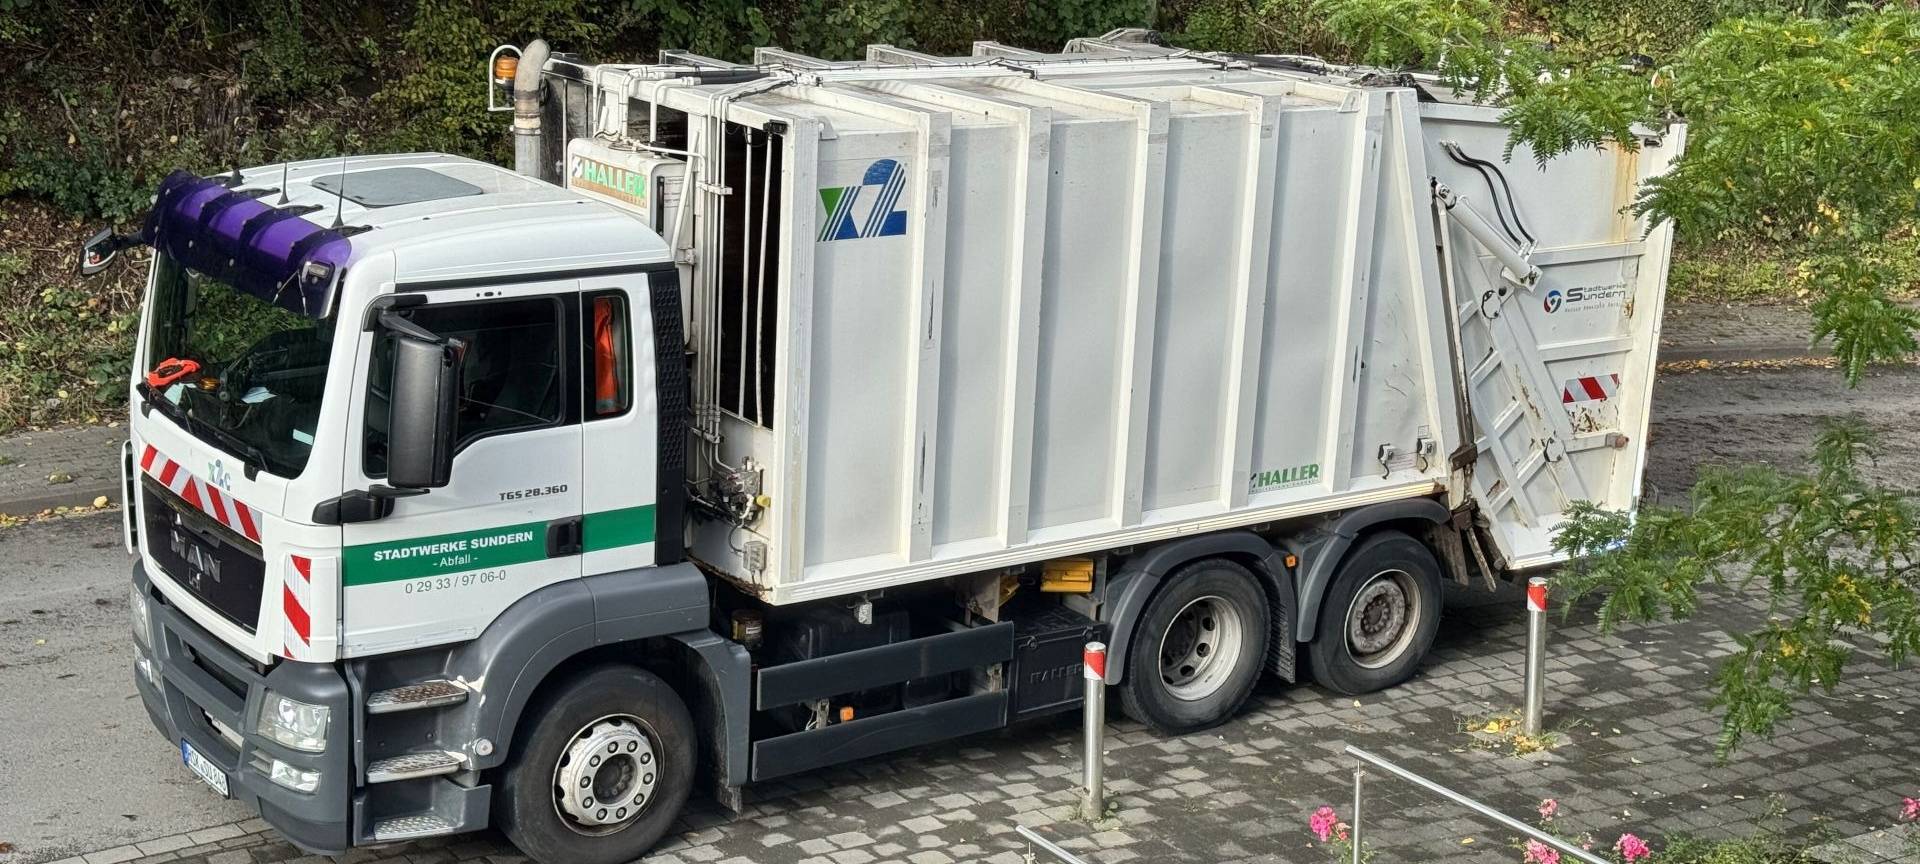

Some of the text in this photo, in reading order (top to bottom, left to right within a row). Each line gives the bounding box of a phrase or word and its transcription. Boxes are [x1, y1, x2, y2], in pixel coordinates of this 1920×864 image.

[584, 159, 646, 199] HALLER
[1258, 463, 1319, 487] HALLER
[500, 484, 568, 501] TGS 28.360
[170, 530, 221, 583] MAN
[374, 531, 533, 562] STADTWERKE SUNDERN
[440, 554, 471, 568] Abfall
[405, 570, 506, 594] 0 29 33 / 97 06-0
